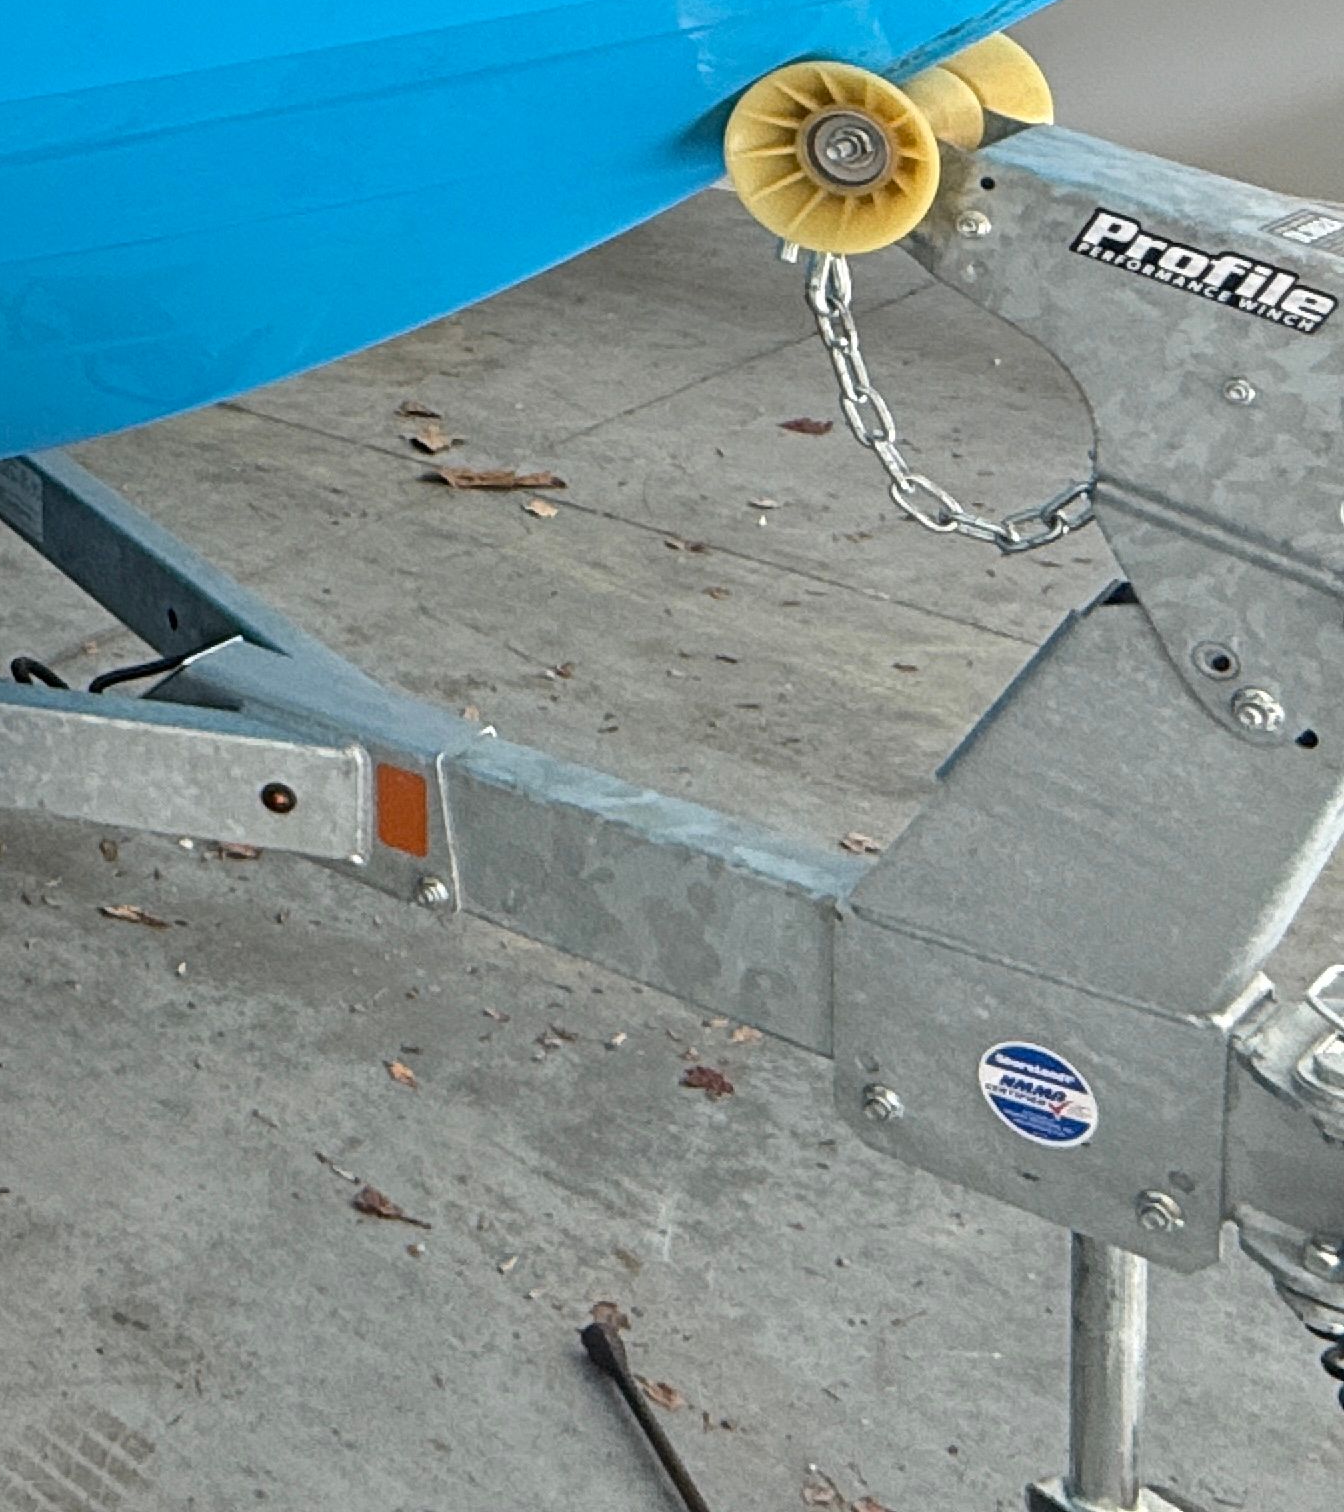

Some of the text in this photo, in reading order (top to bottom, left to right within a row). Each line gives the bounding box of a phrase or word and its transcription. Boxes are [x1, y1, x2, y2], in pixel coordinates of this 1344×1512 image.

[1076, 242, 1315, 333] PERFORMANCE WINCH
[1081, 210, 1337, 323] Profile
